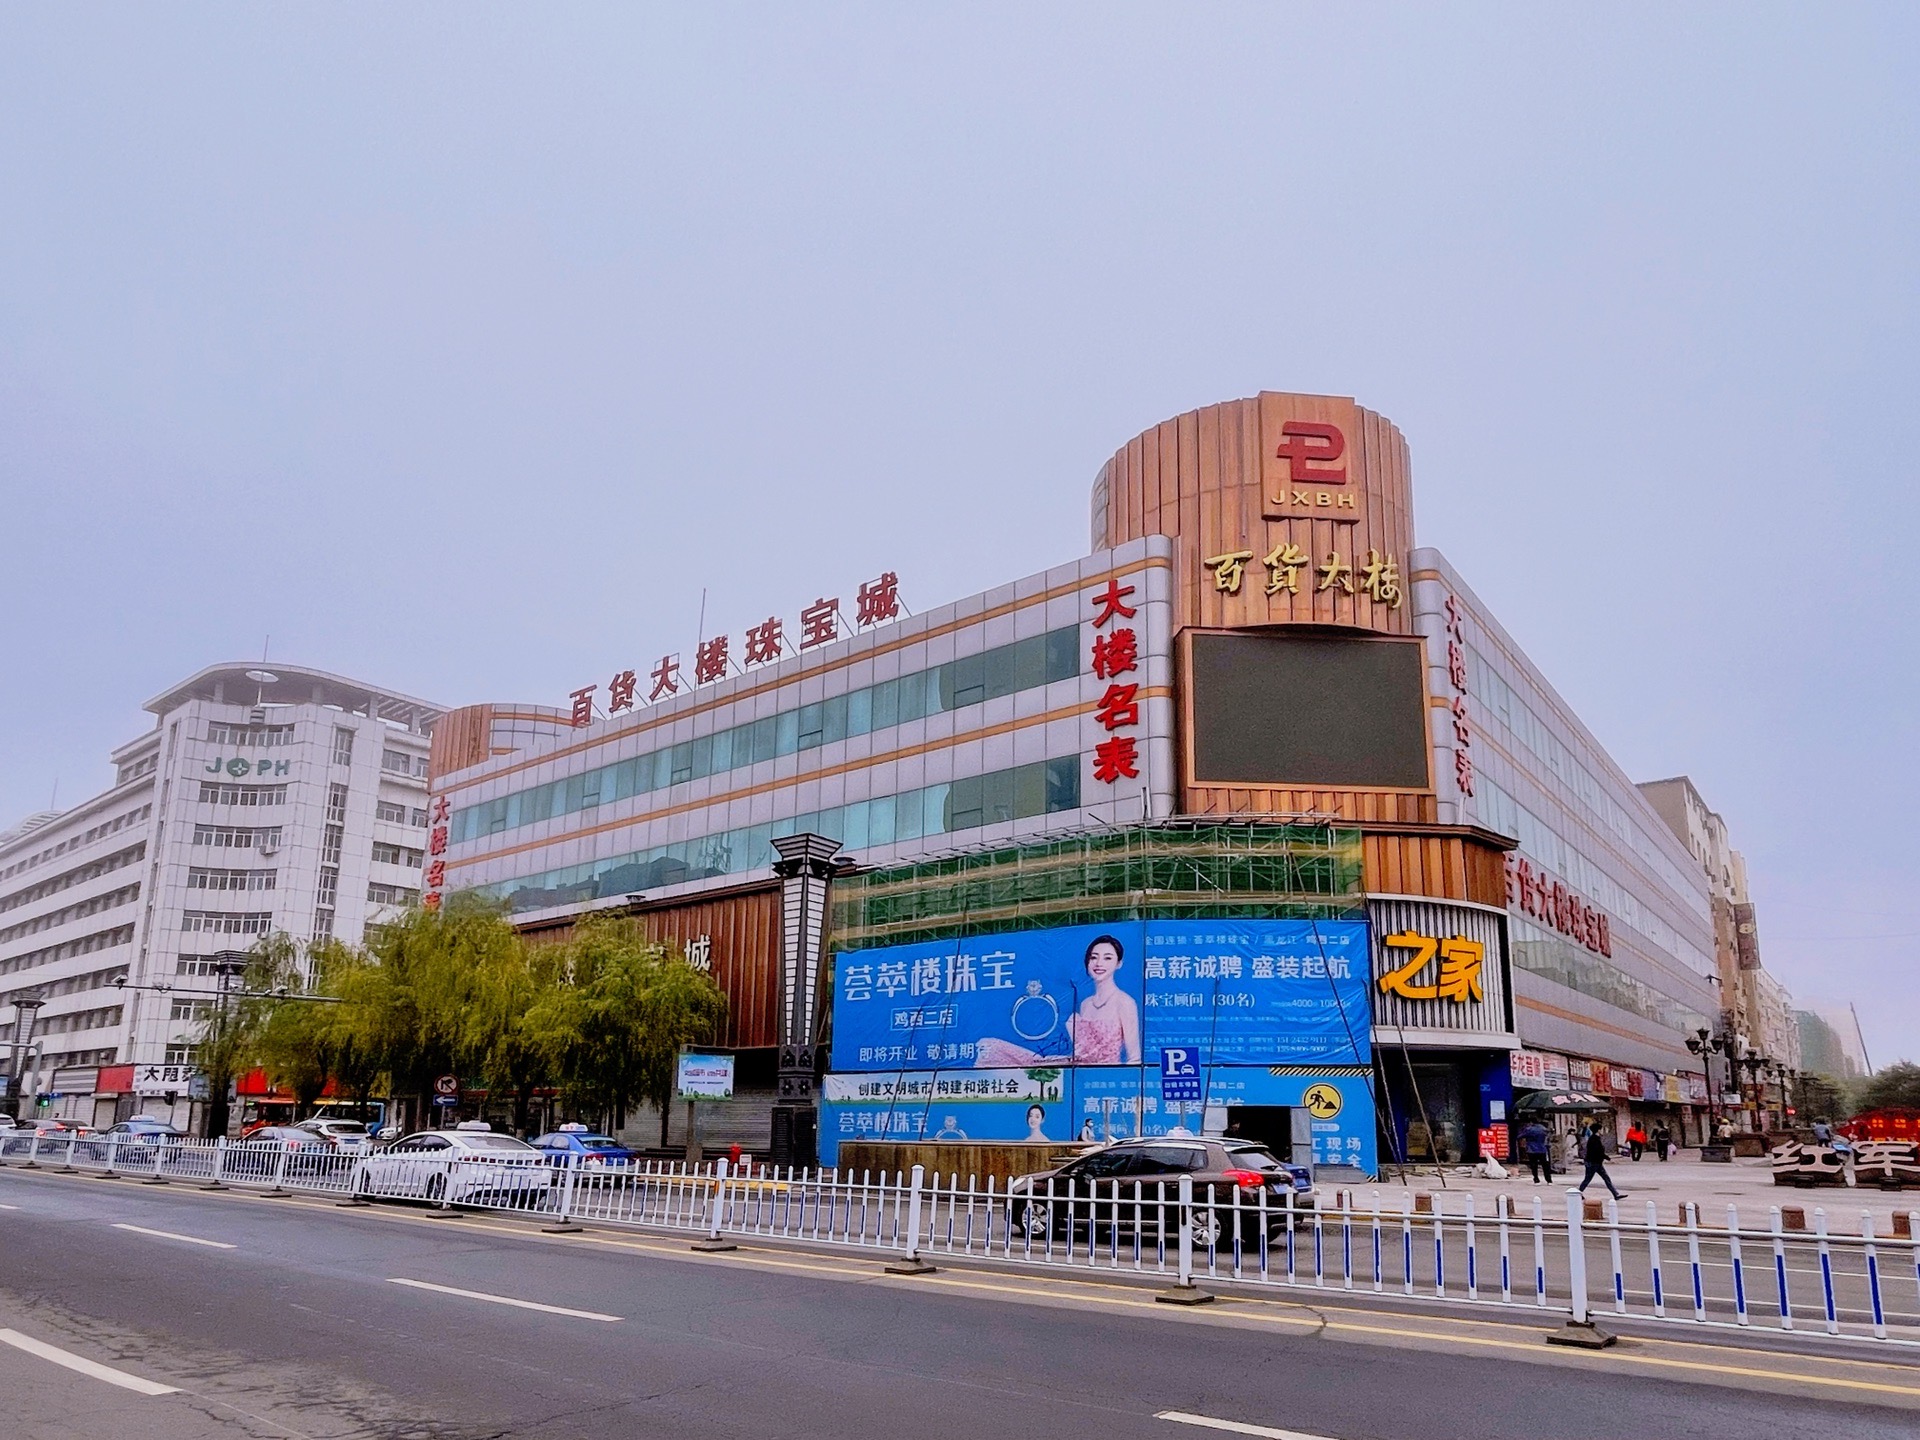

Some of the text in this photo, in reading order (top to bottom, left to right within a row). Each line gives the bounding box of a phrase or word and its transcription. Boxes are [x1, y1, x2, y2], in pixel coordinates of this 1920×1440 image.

[1270, 490, 1356, 509] JXBH
[569, 571, 899, 728] 百货大楼珠宝城
[1091, 579, 1140, 783] 大楼名表
[1444, 594, 1474, 797] 大楼名表
[844, 951, 1016, 1001] 荟萃楼珠宝
[1145, 955, 1352, 980] 高薪诚聘 盛装起航
[1377, 930, 1484, 1003] 之家
[1145, 992, 1204, 1008] 珠宝顾问
[893, 1008, 953, 1028] 鸡西二店
[859, 1041, 992, 1063] 即将开业 敬请期待
[1164, 1048, 1188, 1076] P
[858, 1078, 1020, 1096] 创建文明城市 构建和谐社会
[838, 1111, 929, 1133] 荟萃楼珠宝
